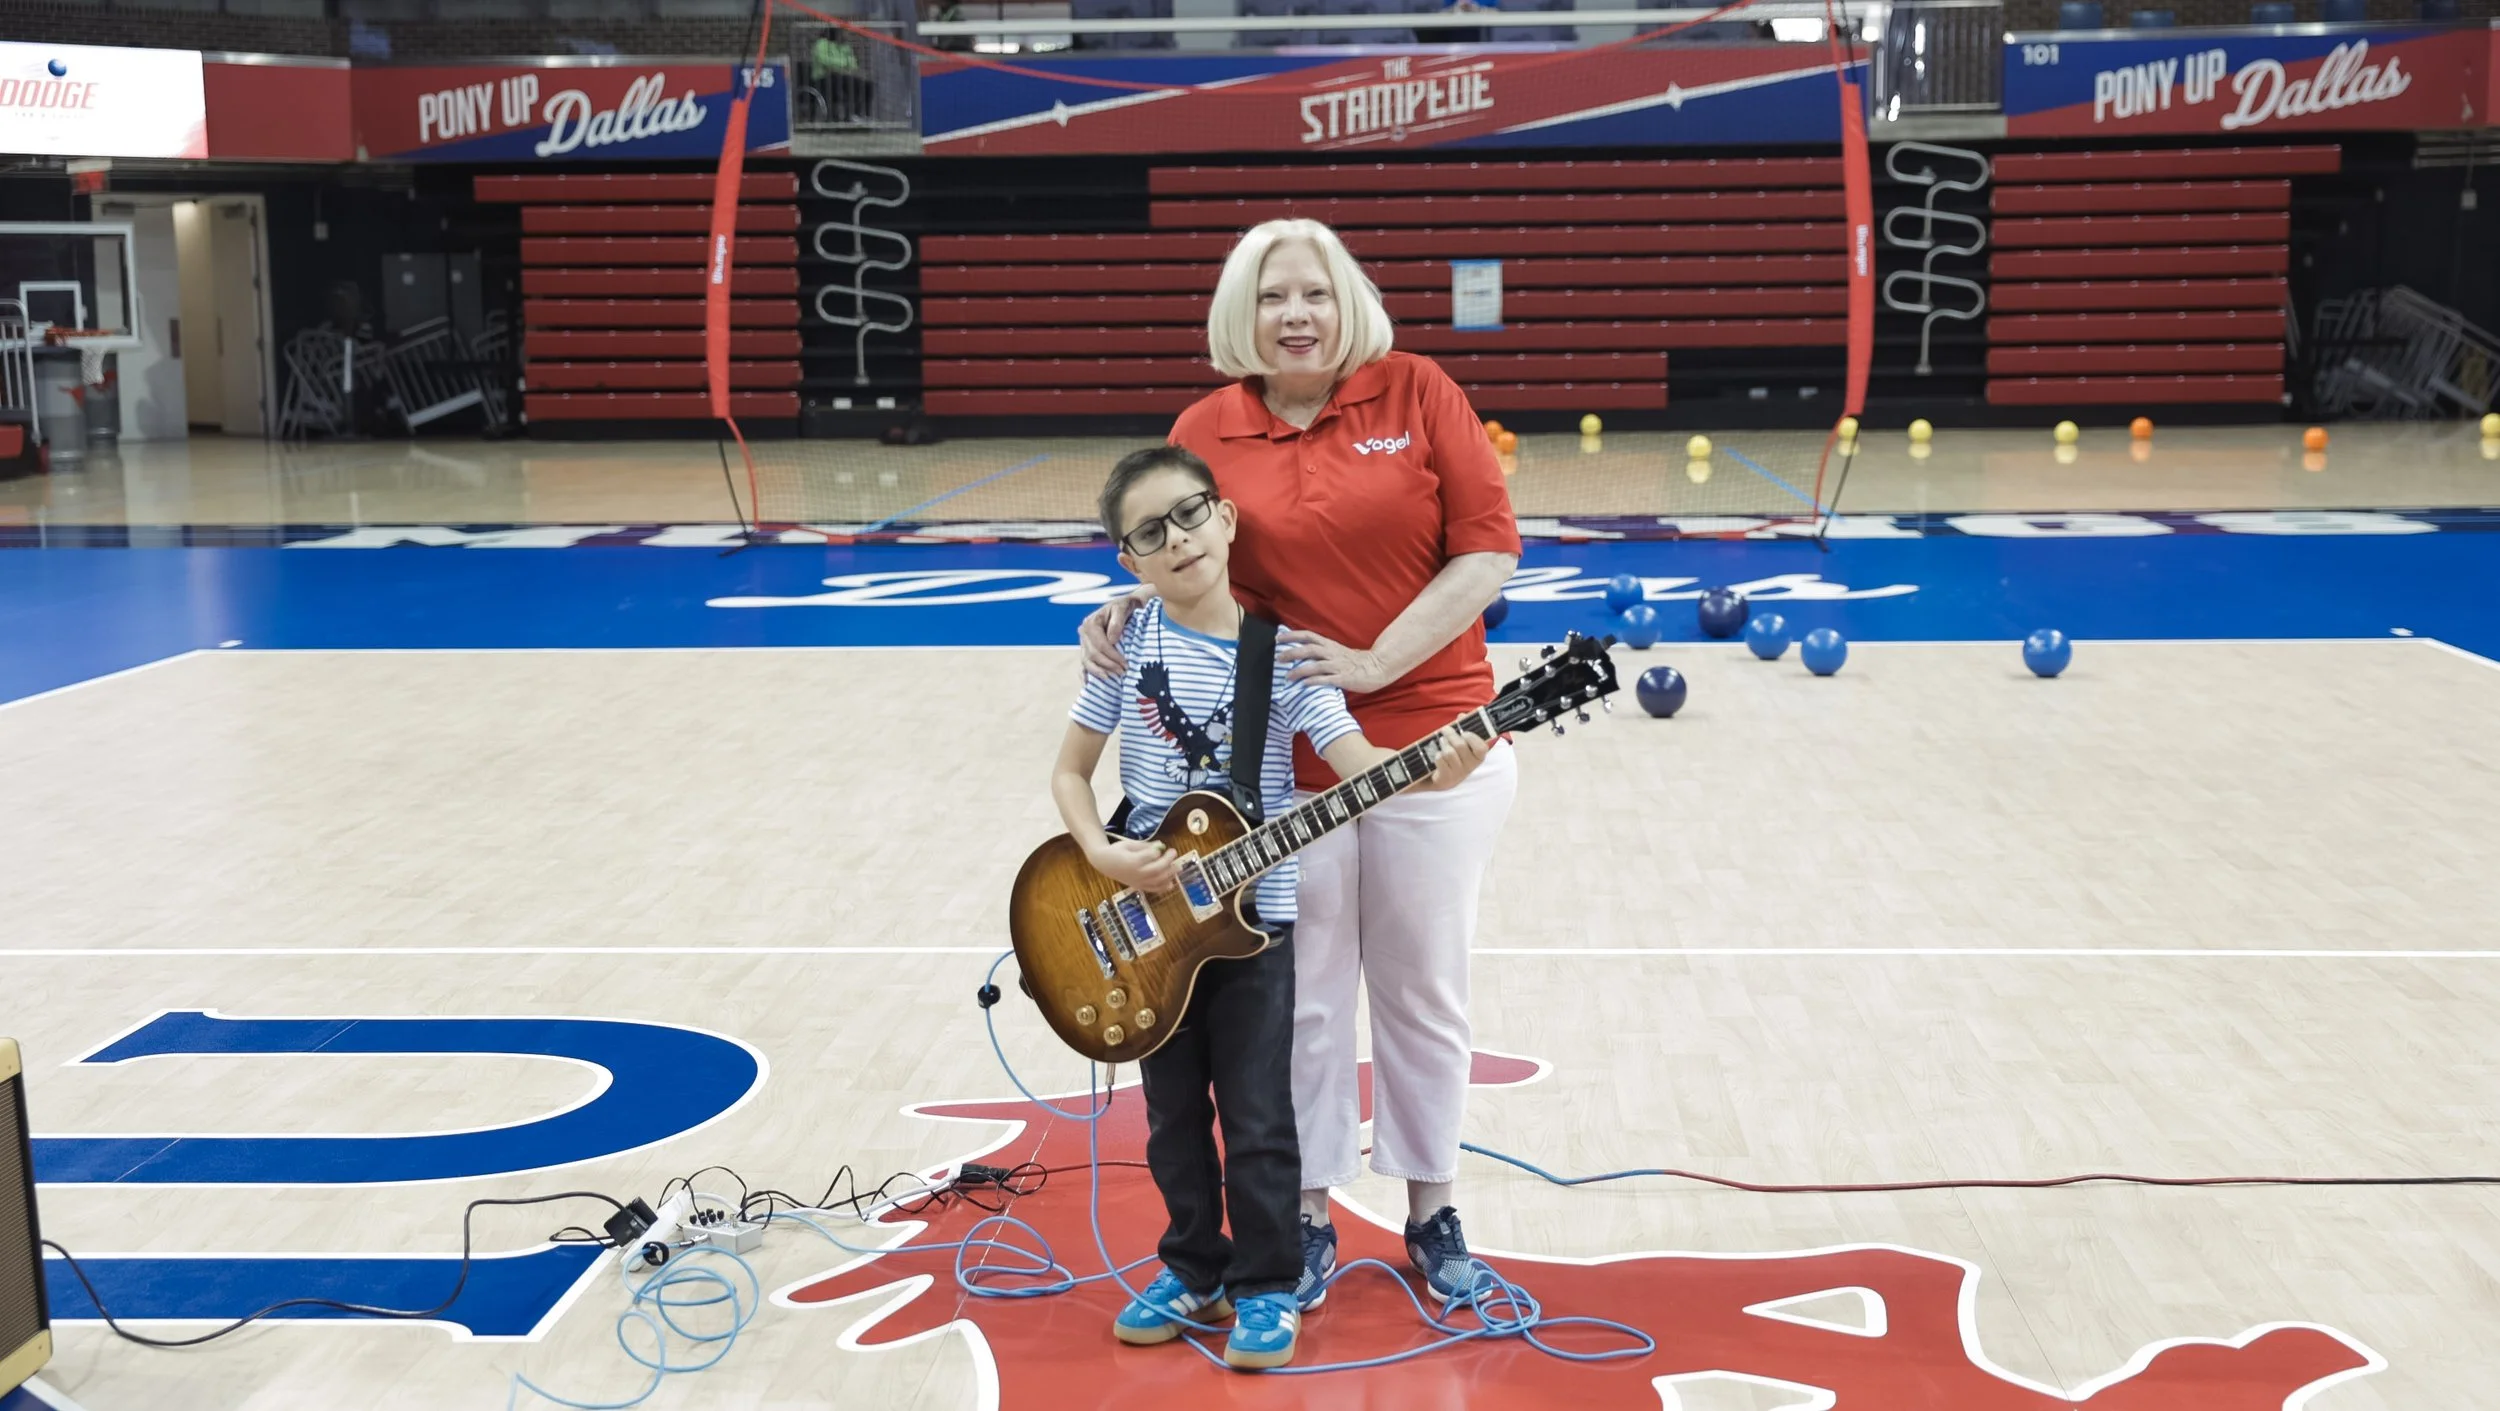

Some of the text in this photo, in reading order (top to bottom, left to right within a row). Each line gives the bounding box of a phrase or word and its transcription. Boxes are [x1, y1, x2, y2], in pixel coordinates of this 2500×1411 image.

[1381, 56, 1411, 81] THE
[2022, 44, 2059, 65] 101
[0, 78, 99, 109] DODGE
[2094, 38, 2412, 131] PONY UP Dallas
[418, 72, 707, 158] PONY UP Dallas
[1352, 430, 1410, 455] Vogel
